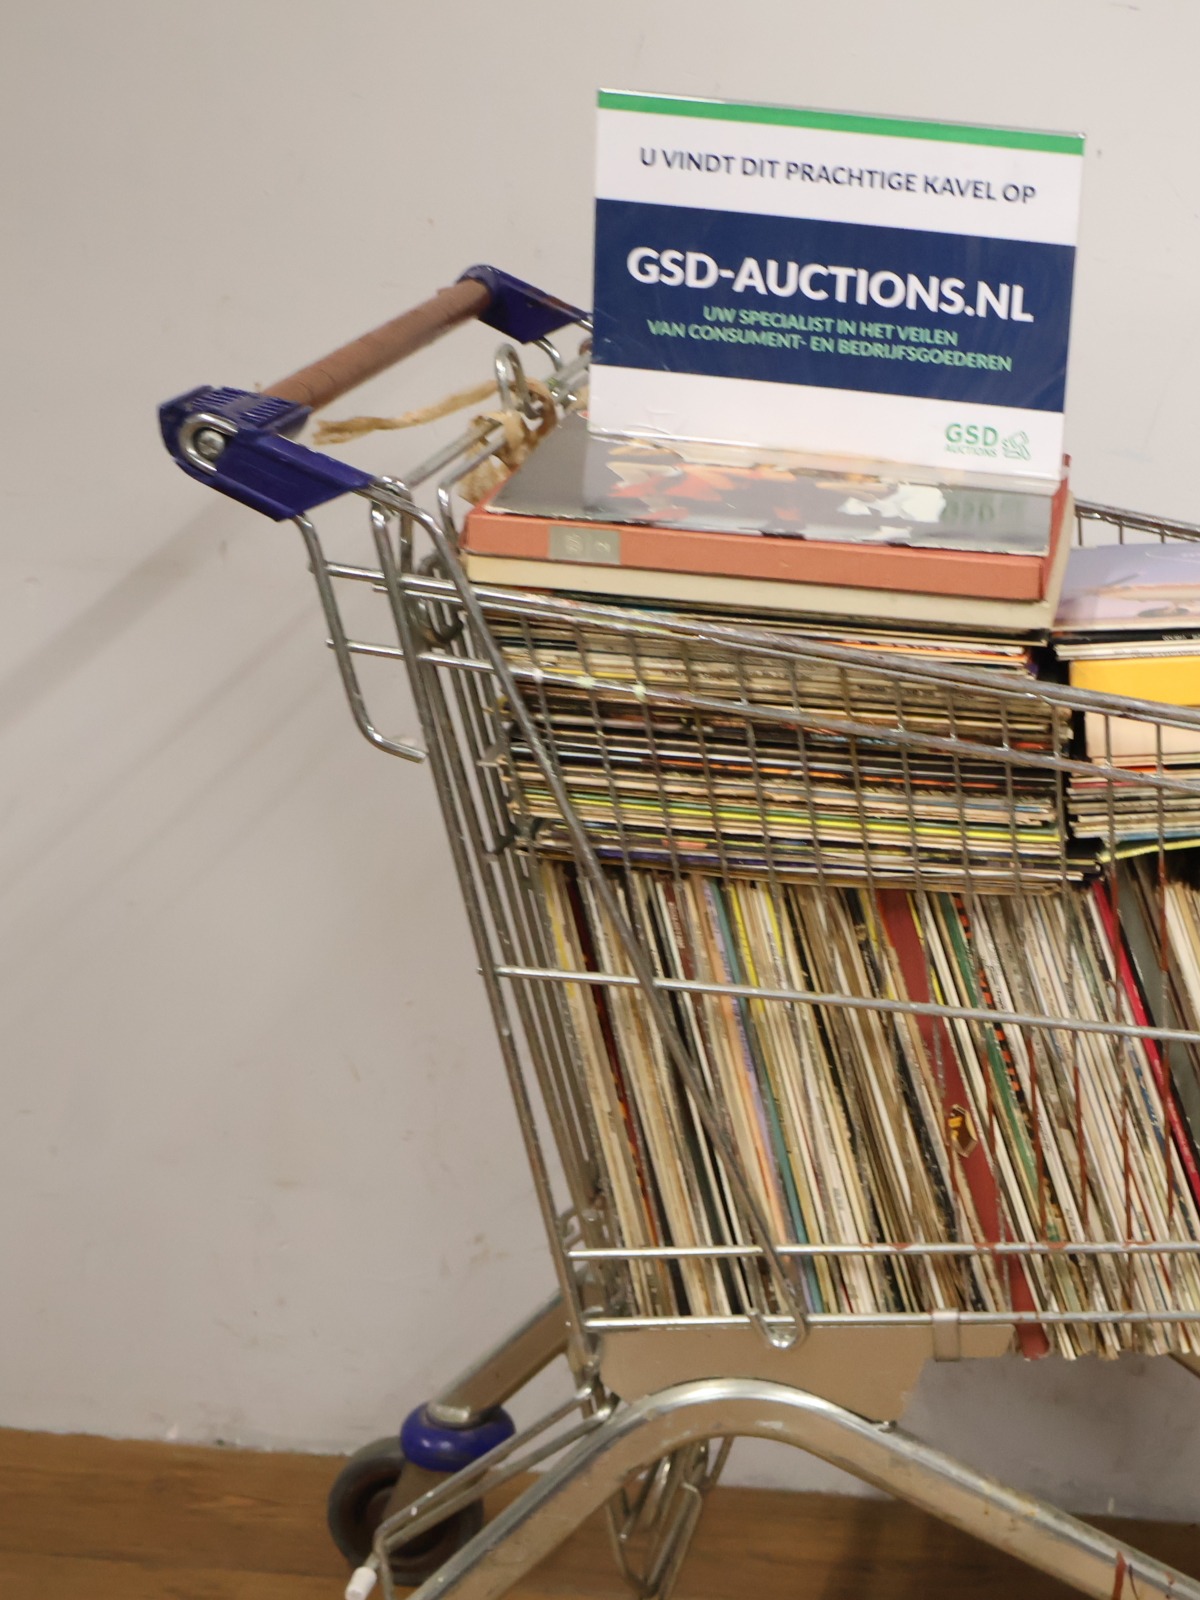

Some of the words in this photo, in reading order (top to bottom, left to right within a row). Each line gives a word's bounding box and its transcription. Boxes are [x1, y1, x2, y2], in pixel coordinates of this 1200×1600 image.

[640, 147, 657, 167] U
[662, 149, 736, 174] VINDT
[741, 156, 782, 179] DIT
[786, 161, 918, 193] PRACHTIGE
[923, 174, 998, 201] KAVEL
[1002, 183, 1038, 204] OP
[626, 246, 1035, 323] GSD-AUCTIONS.NL
[646, 319, 686, 338] VAN
[687, 323, 807, 350] CONSUMENT-
[810, 335, 834, 353] EN
[837, 337, 1012, 372] BEDRIJFSGOEDEREN
[703, 305, 737, 324] UW
[738, 309, 835, 333] SPECIALIST
[836, 319, 857, 336] IN
[859, 320, 895, 340] HET
[896, 324, 958, 346] VEILEN
[945, 423, 998, 447] GSD
